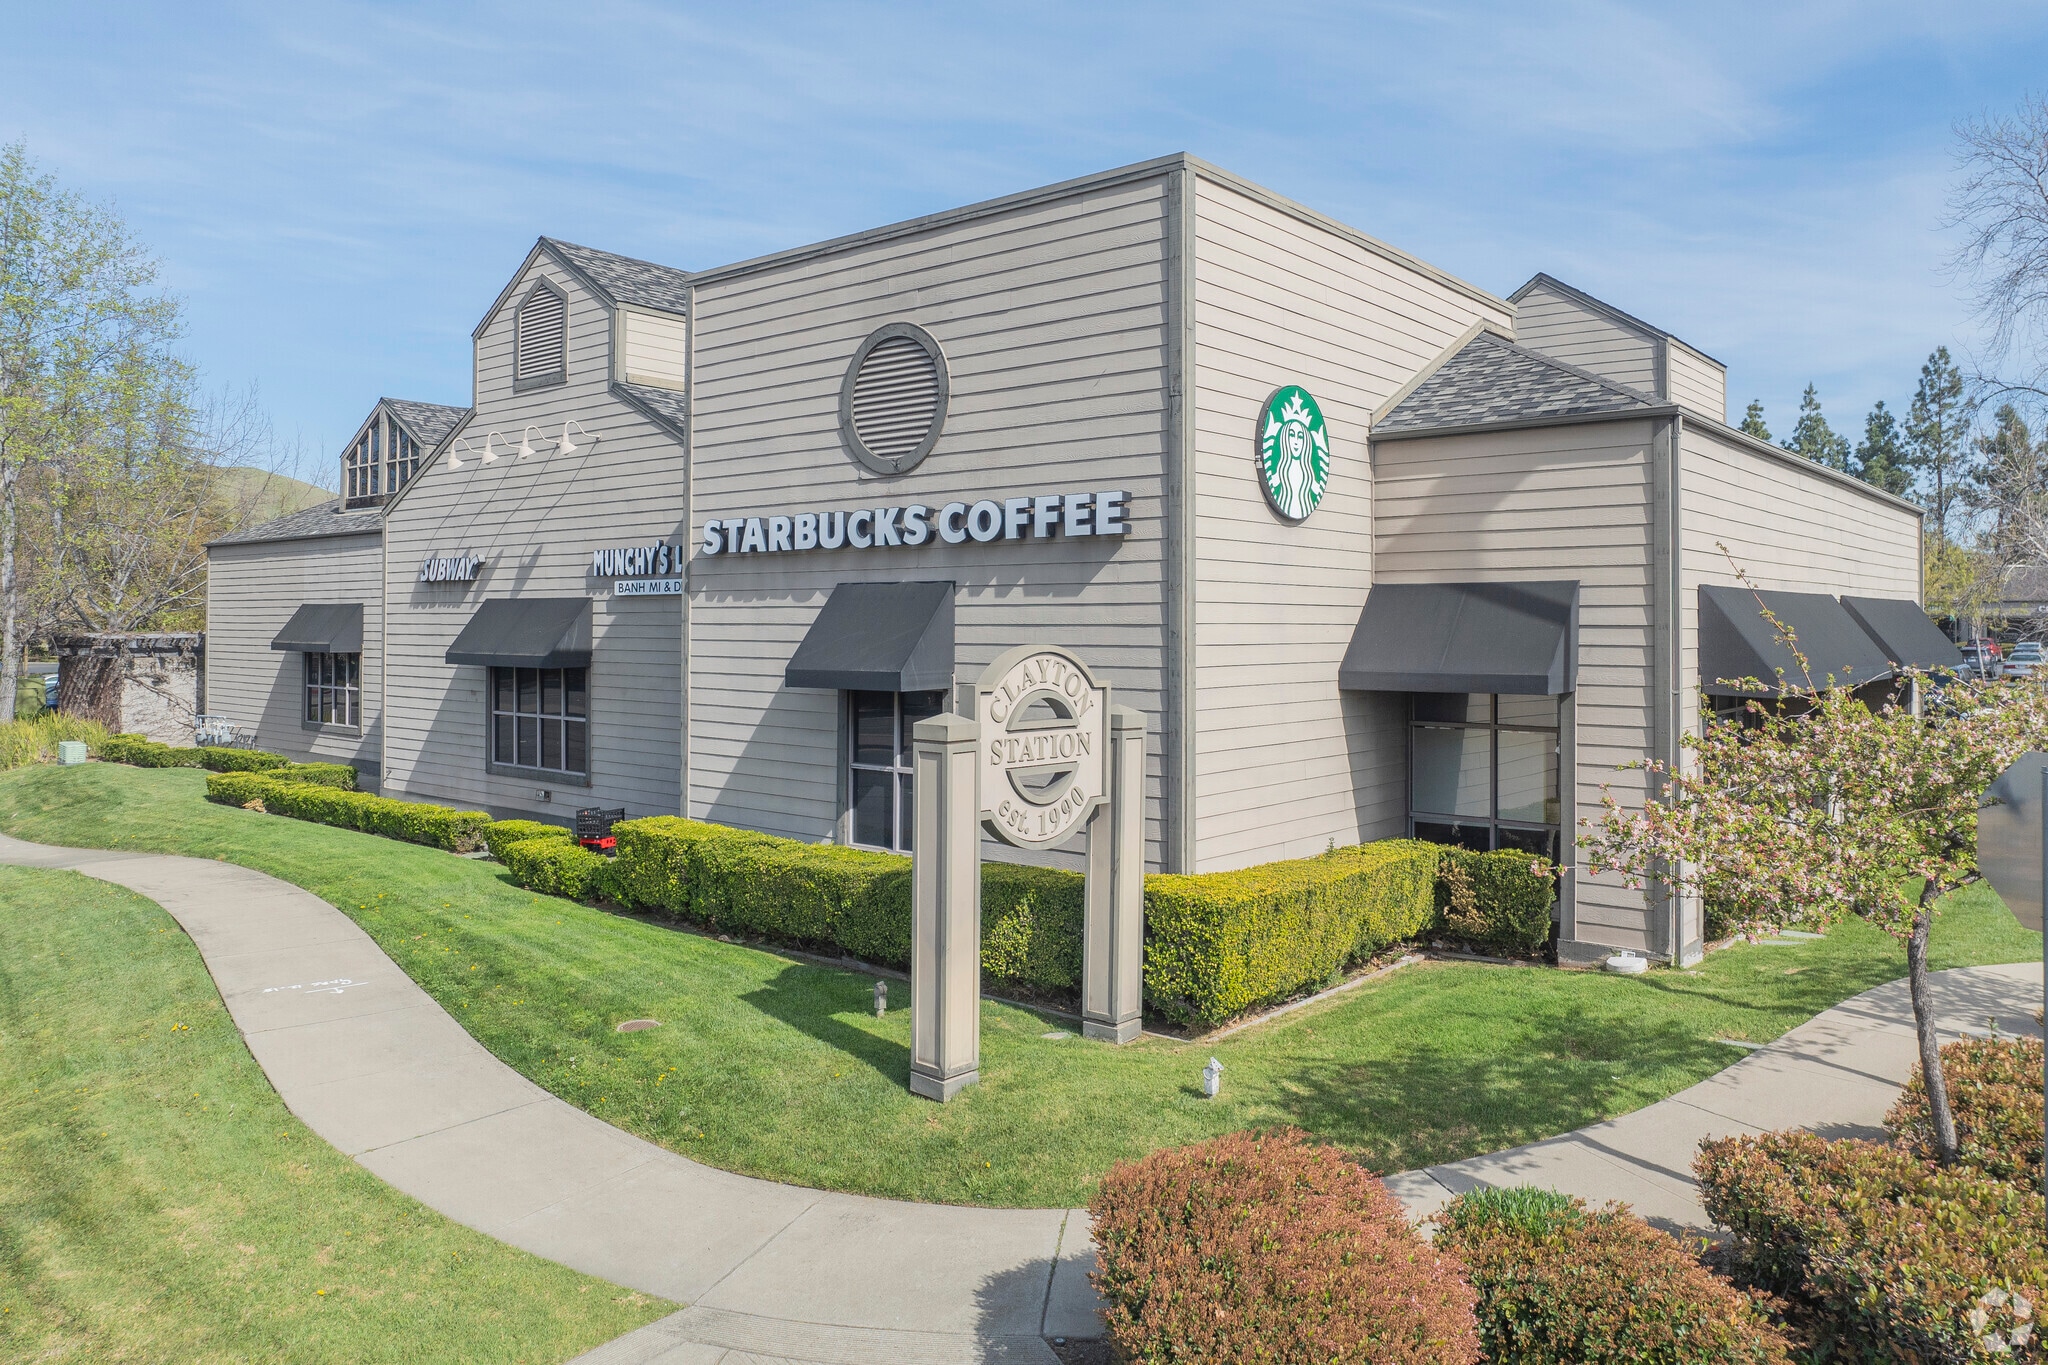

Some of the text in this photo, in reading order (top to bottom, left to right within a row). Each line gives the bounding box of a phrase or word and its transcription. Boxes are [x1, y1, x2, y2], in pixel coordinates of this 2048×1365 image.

[702, 490, 1131, 555] STARBUCKS COFFEE
[420, 555, 480, 582] SUBWAY
[593, 539, 671, 577] MUNCHY'S
[618, 582, 646, 593] BANH
[649, 582, 661, 593] MI
[664, 581, 672, 592] &
[990, 658, 1094, 724] CLAYTON
[990, 731, 1093, 766] STATION
[1037, 786, 1085, 837] 1990
